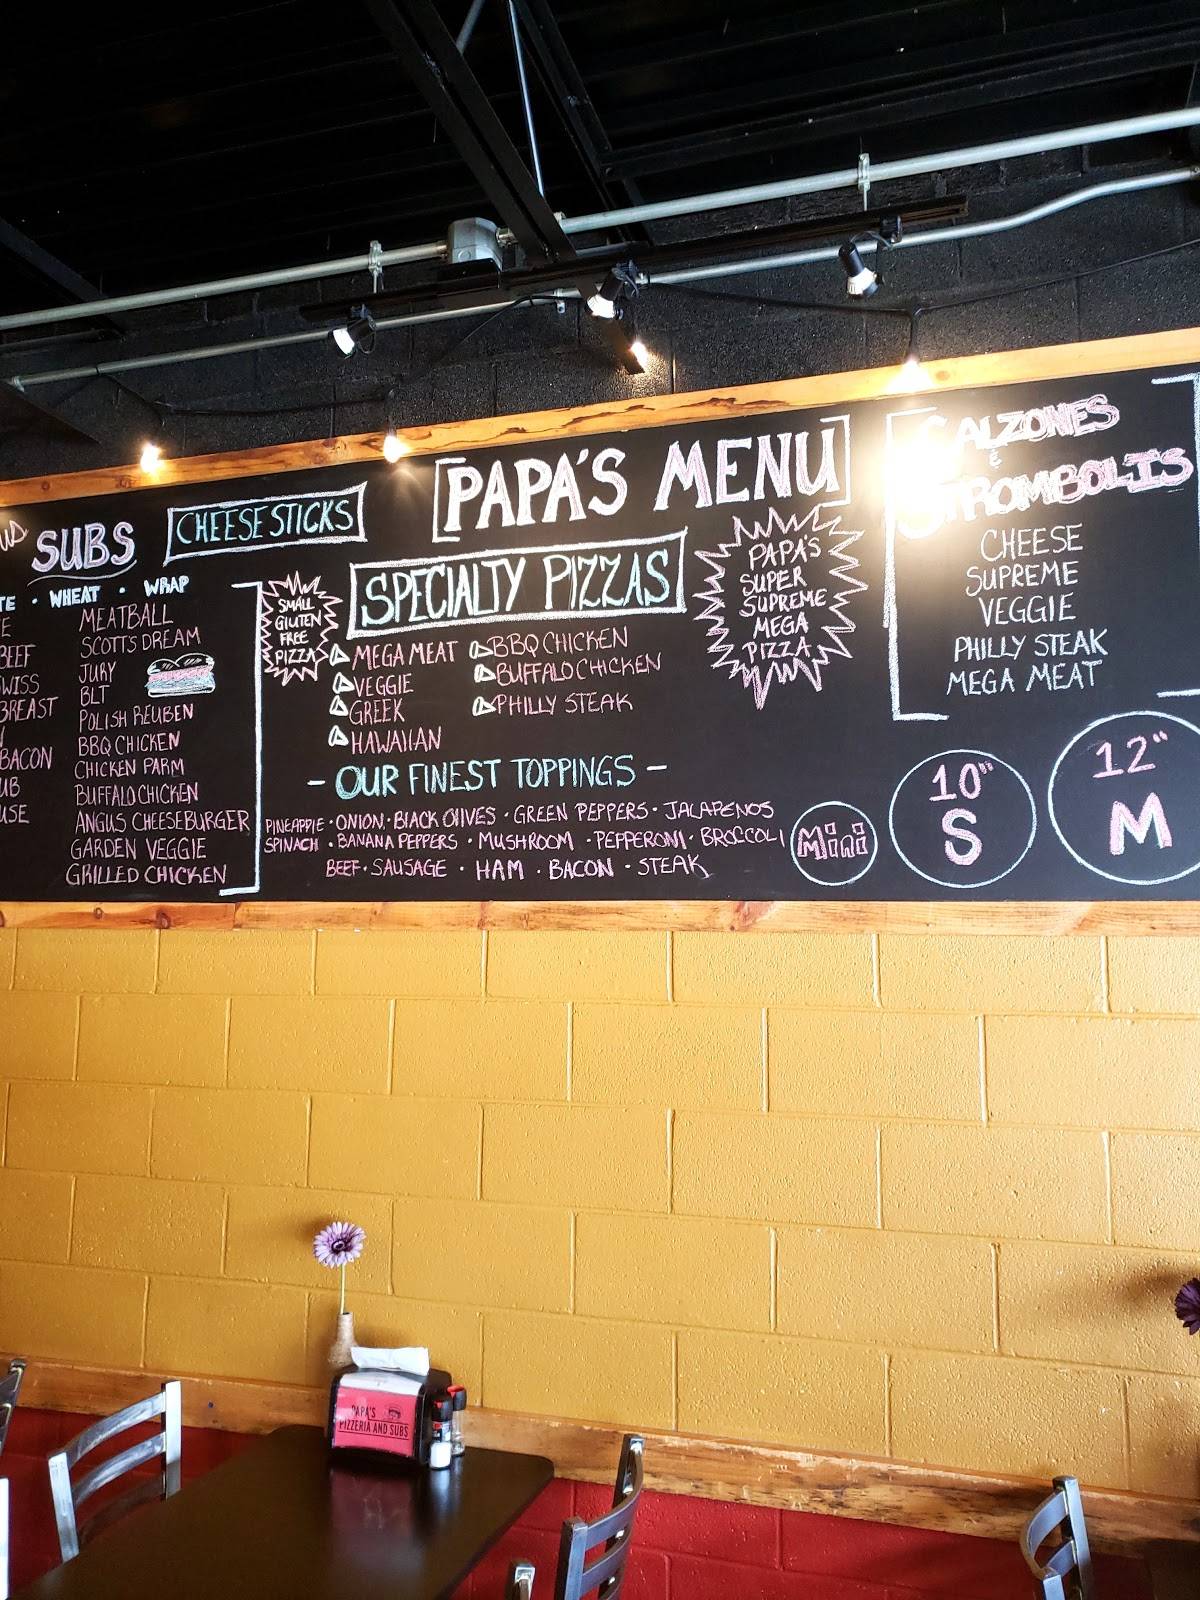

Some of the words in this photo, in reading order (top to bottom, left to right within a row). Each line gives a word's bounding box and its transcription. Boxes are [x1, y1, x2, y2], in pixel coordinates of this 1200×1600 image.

[443, 448, 628, 532] PAPA'S
[653, 427, 840, 511] MENU
[896, 448, 1194, 539] TROMBOLIS
[176, 506, 268, 544] CHEESE
[270, 500, 353, 537] STICKS
[31, 521, 136, 573] SUBS
[748, 534, 823, 571] PAPA'S
[980, 524, 1083, 562] CHEESE
[49, 585, 101, 608] WHEAT
[143, 575, 190, 597] WRAP
[361, 557, 526, 627] SPECIALTY
[544, 549, 669, 612] PIZZAS
[738, 565, 808, 597] SUPER
[965, 561, 1080, 597] SUPREME
[78, 603, 174, 633] MEATBALL
[278, 596, 316, 613] SMALL
[738, 589, 828, 618] SUPREME
[978, 593, 1077, 627] VEGGIE
[142, 625, 202, 651] DREAM
[279, 630, 309, 646] FREE
[752, 611, 810, 639] MEGA
[274, 648, 316, 666] PIZZA
[351, 645, 405, 671] MEGA
[408, 640, 459, 665] MEAT
[486, 633, 539, 658] BBQ
[541, 626, 630, 654] CHICKEN
[741, 635, 813, 663] PIZZA
[953, 635, 1028, 664] PHILLY
[1034, 628, 1109, 658] STEAK
[494, 661, 575, 687] BUFFALO
[576, 652, 663, 680] CHICKEN
[946, 668, 1016, 697] MEGA
[1025, 660, 1104, 692] MEAT
[0, 674, 40, 696] WISS
[80, 685, 110, 707] BLT
[353, 673, 415, 697] VEGGIE
[79, 710, 128, 733] POLISH
[133, 703, 194, 727] REUBEN
[349, 698, 406, 726] GREEK
[496, 694, 557, 716] PHILLY
[564, 692, 634, 714] STEAK
[78, 736, 112, 757] BBQ
[115, 730, 181, 753] CHICKEN
[1092, 730, 1169, 778] 12"
[74, 759, 136, 780] CHICKEN
[143, 757, 185, 777] PARM
[335, 763, 400, 800] OUR
[408, 759, 501, 796] FINEST
[509, 754, 637, 789] TOPPINGS
[928, 760, 996, 802] 10"
[74, 784, 136, 807] BUFFALO
[137, 782, 199, 805] CHICKEN
[75, 810, 127, 834] ANGUS
[131, 810, 251, 832] CHEESEBURGER
[513, 804, 569, 825] GREEN
[574, 801, 650, 823] PEPPERS
[663, 800, 775, 821] JALAPENOS
[1108, 792, 1173, 856] M
[70, 837, 137, 861] GARDEN
[145, 837, 207, 860] VEGGIE
[263, 837, 319, 853] SPINACH
[337, 833, 394, 851] BANANA
[398, 833, 458, 851] PEPPERS
[478, 831, 575, 852] MUSHROOM
[593, 830, 688, 851] PEPPERONI
[699, 825, 787, 849] BROCCOLI
[941, 807, 983, 867] S
[65, 863, 140, 886] GRILLED
[143, 864, 227, 885] CHICKEN
[325, 859, 362, 878] BEEF
[370, 858, 447, 878] SAUSAGE
[475, 859, 525, 881] HAM
[548, 857, 615, 880] BACON
[636, 853, 712, 880] STEAK
[339, 1419, 371, 1433] PIZZERIA
[372, 1422, 388, 1435] AND
[389, 1424, 409, 1438] SUBS
